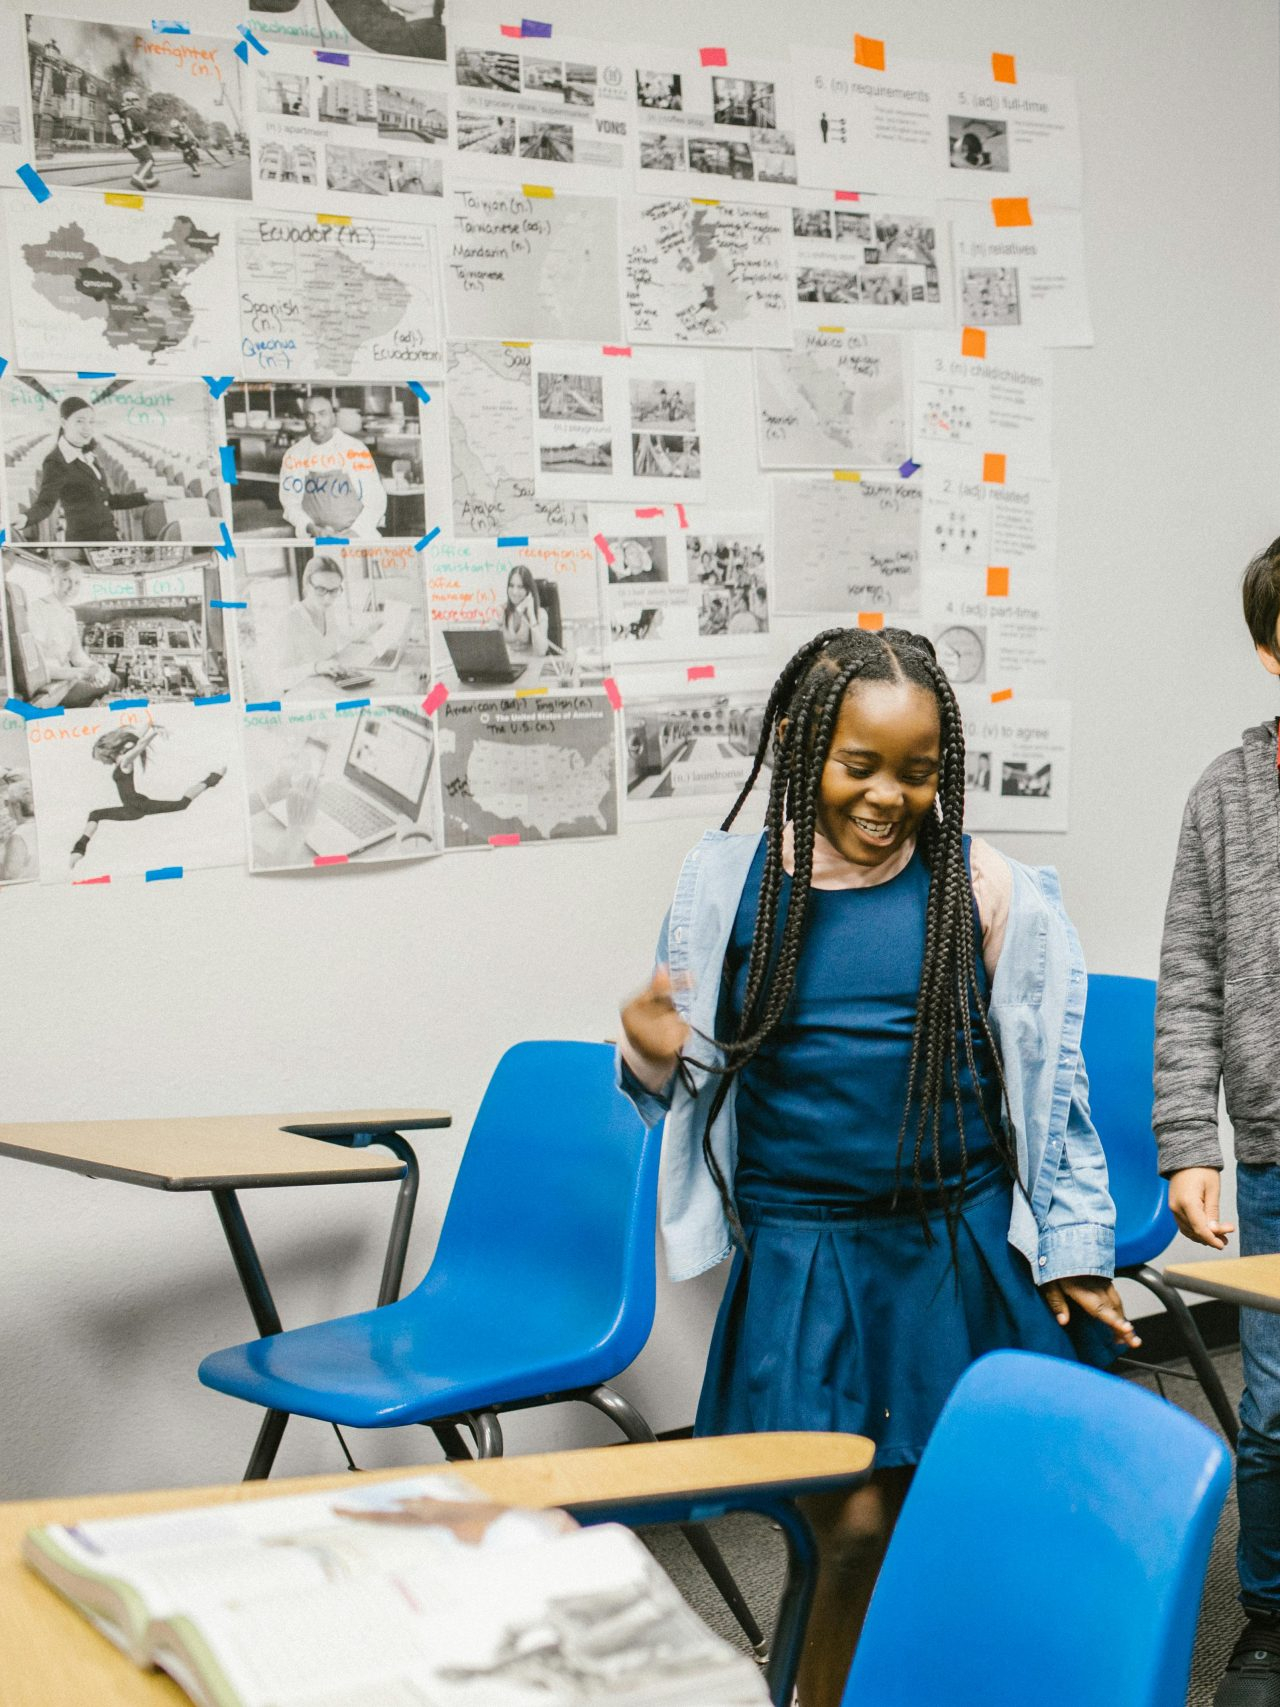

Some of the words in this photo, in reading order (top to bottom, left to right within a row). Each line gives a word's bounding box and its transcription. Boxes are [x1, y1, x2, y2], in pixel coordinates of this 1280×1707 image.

[132, 36, 219, 67] Firefighter
[191, 62, 222, 80] (n.)
[851, 83, 931, 104] requirements
[1002, 97, 1049, 114] full-time
[283, 124, 329, 138] apartment
[594, 118, 628, 136] VONS
[258, 221, 333, 243] Ecuador
[453, 215, 520, 235] Taiwanese
[453, 243, 509, 259] Mandarin
[987, 242, 1038, 257] relatives
[449, 264, 505, 281] Taiwanese
[241, 293, 300, 319] Spanish
[251, 314, 283, 333] (n.)
[126, 407, 166, 426] (n.)
[989, 488, 1030, 504] related
[989, 605, 1041, 620] part-time
[445, 701, 499, 717] American
[534, 699, 573, 713] English
[495, 714, 510, 723] The
[511, 712, 537, 722] United
[537, 711, 560, 721] States
[561, 711, 571, 720] of
[572, 710, 604, 720] America
[243, 714, 282, 728] social
[287, 711, 327, 724] media
[29, 719, 102, 744] dancer
[1001, 725, 1014, 738] to
[1016, 727, 1050, 742] agree
[691, 768, 745, 782] laundromat
